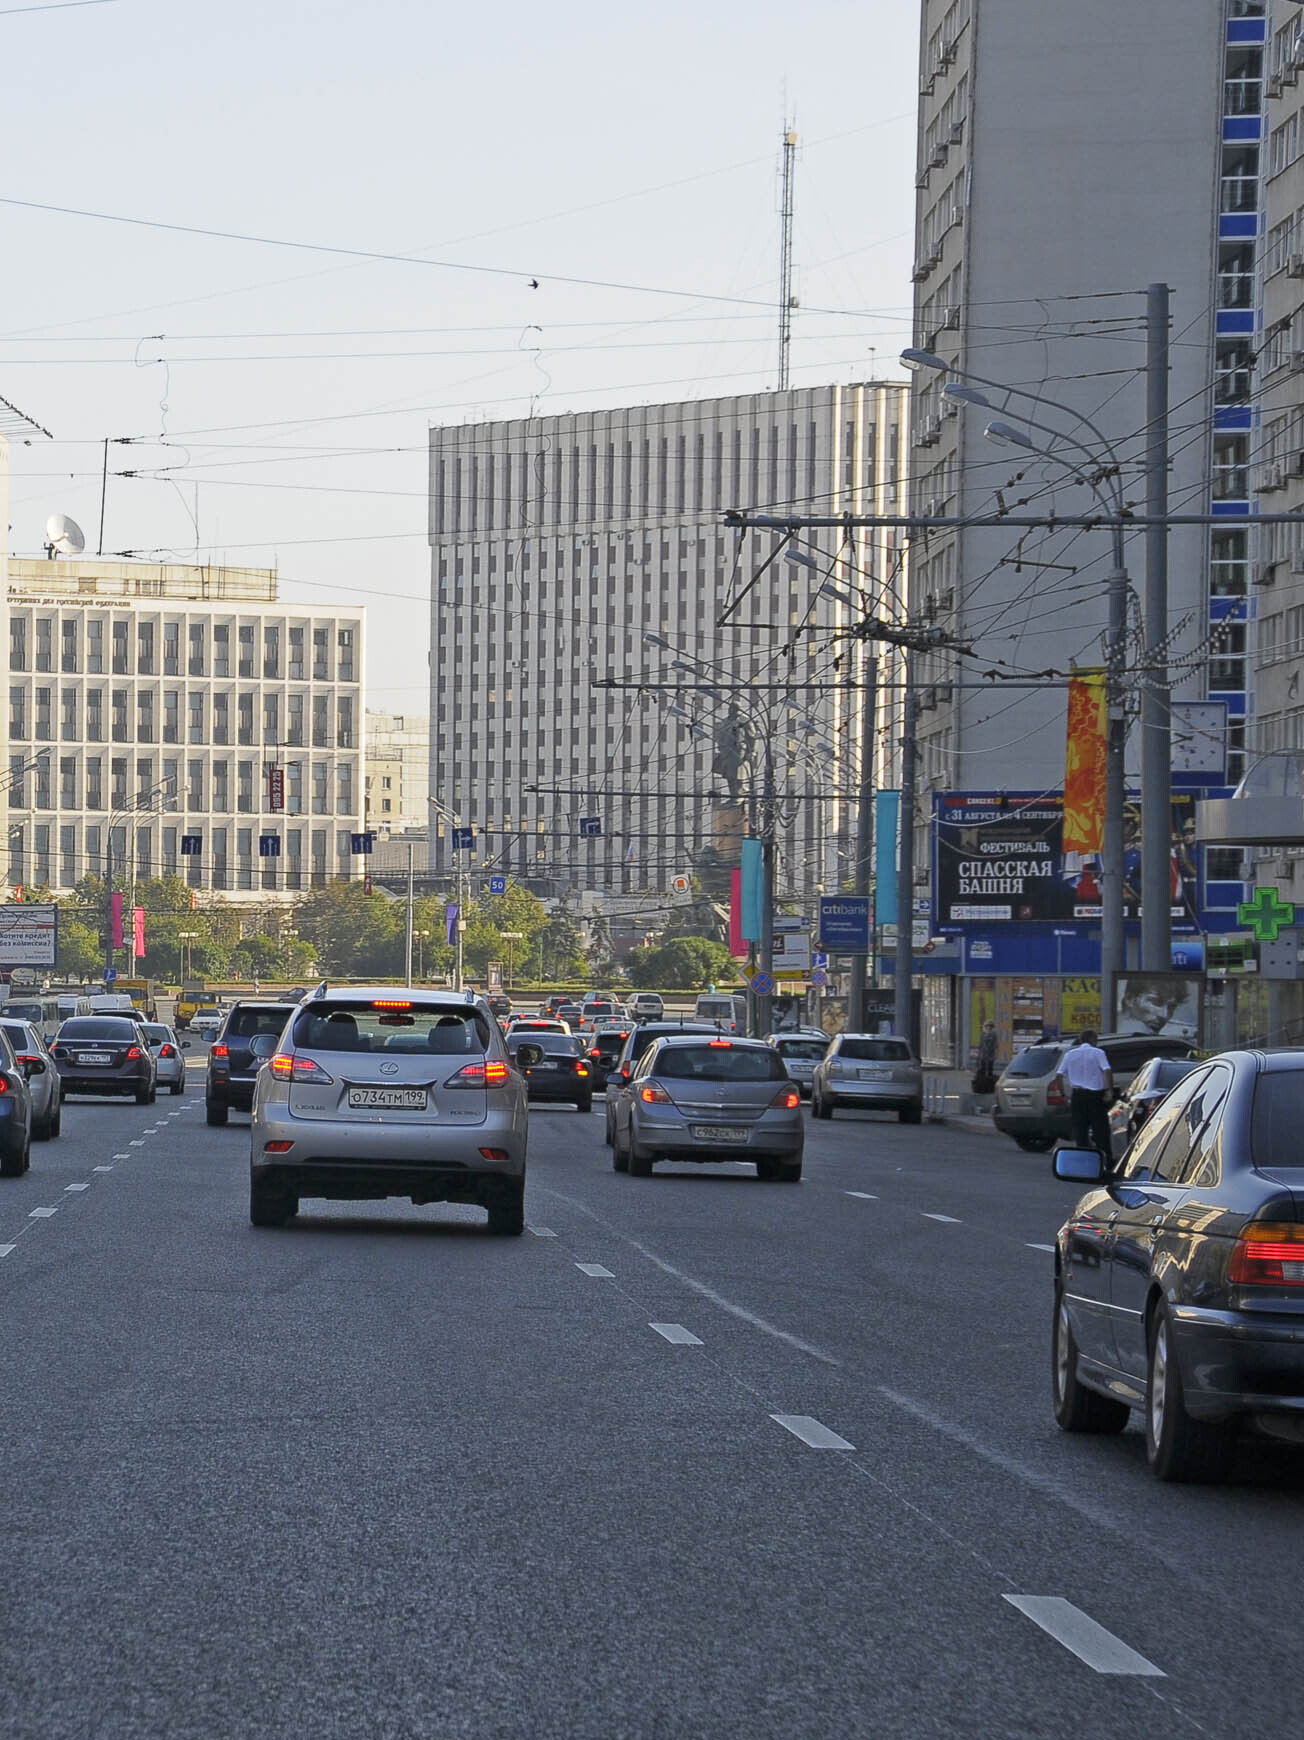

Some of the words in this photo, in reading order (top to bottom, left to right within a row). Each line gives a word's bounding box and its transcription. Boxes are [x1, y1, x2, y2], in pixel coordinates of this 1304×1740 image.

[980, 841, 1051, 853] ФЕСТИВАЛЬ
[959, 860, 1053, 877] СПАССКАЯ
[492, 881, 503, 889] 50
[959, 878, 1025, 894] БАШНЯ
[822, 904, 868, 915] citibank
